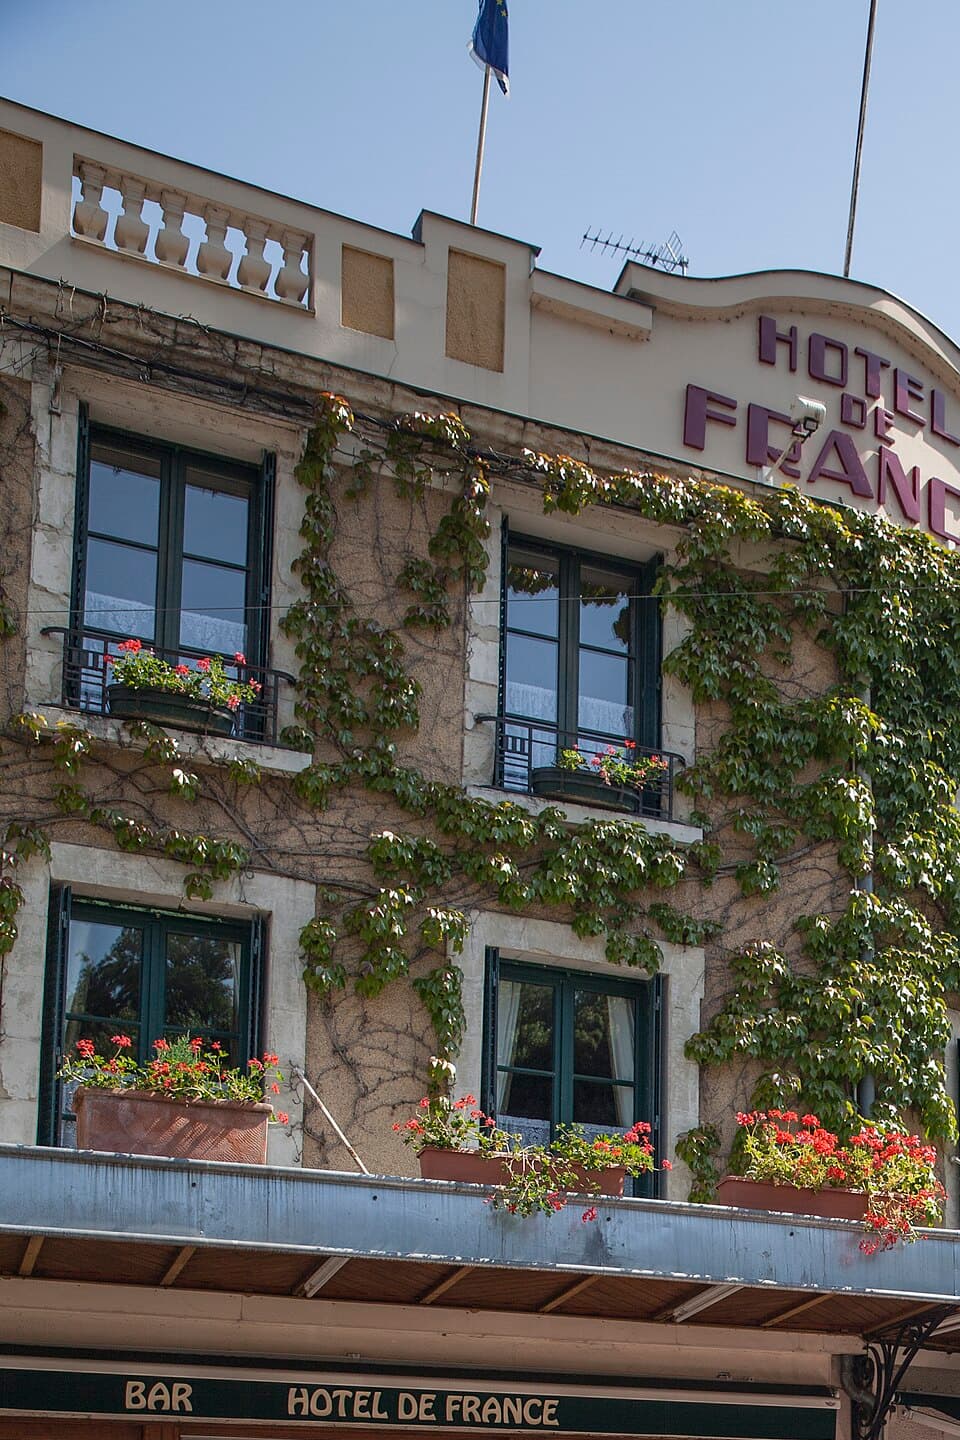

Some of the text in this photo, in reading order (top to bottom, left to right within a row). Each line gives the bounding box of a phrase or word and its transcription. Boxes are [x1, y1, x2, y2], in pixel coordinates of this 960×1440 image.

[840, 392, 895, 444] DE
[125, 1380, 193, 1412] BAR
[287, 1387, 560, 1427] HOTEL DE FRANCE
